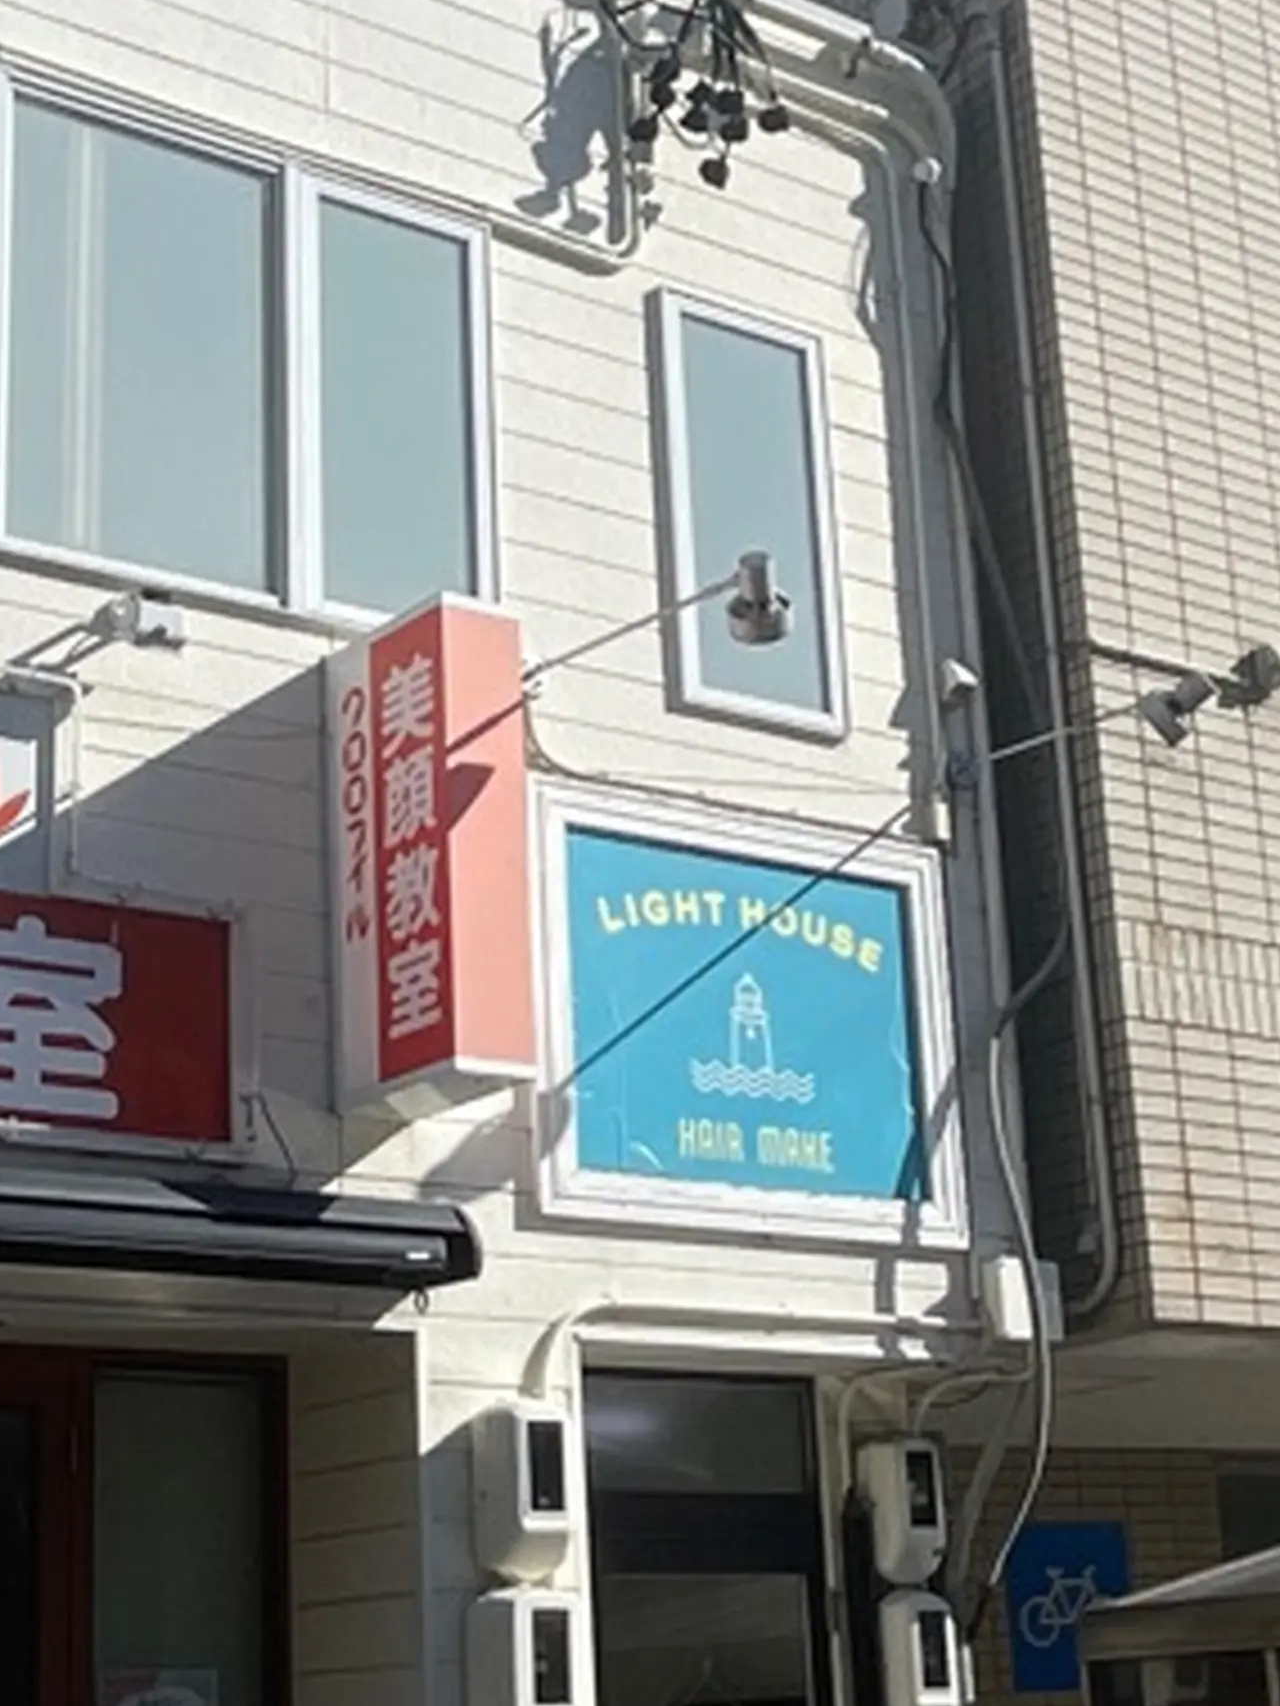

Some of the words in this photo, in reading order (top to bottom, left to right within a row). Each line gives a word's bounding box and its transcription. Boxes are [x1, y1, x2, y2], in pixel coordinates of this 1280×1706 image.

[380, 653, 444, 1040] 美顔教室
[598, 891, 726, 934] LIGHT
[739, 895, 884, 974] HOUSE
[677, 1118, 743, 1163] HAIR
[756, 1125, 837, 1173] MAKE
